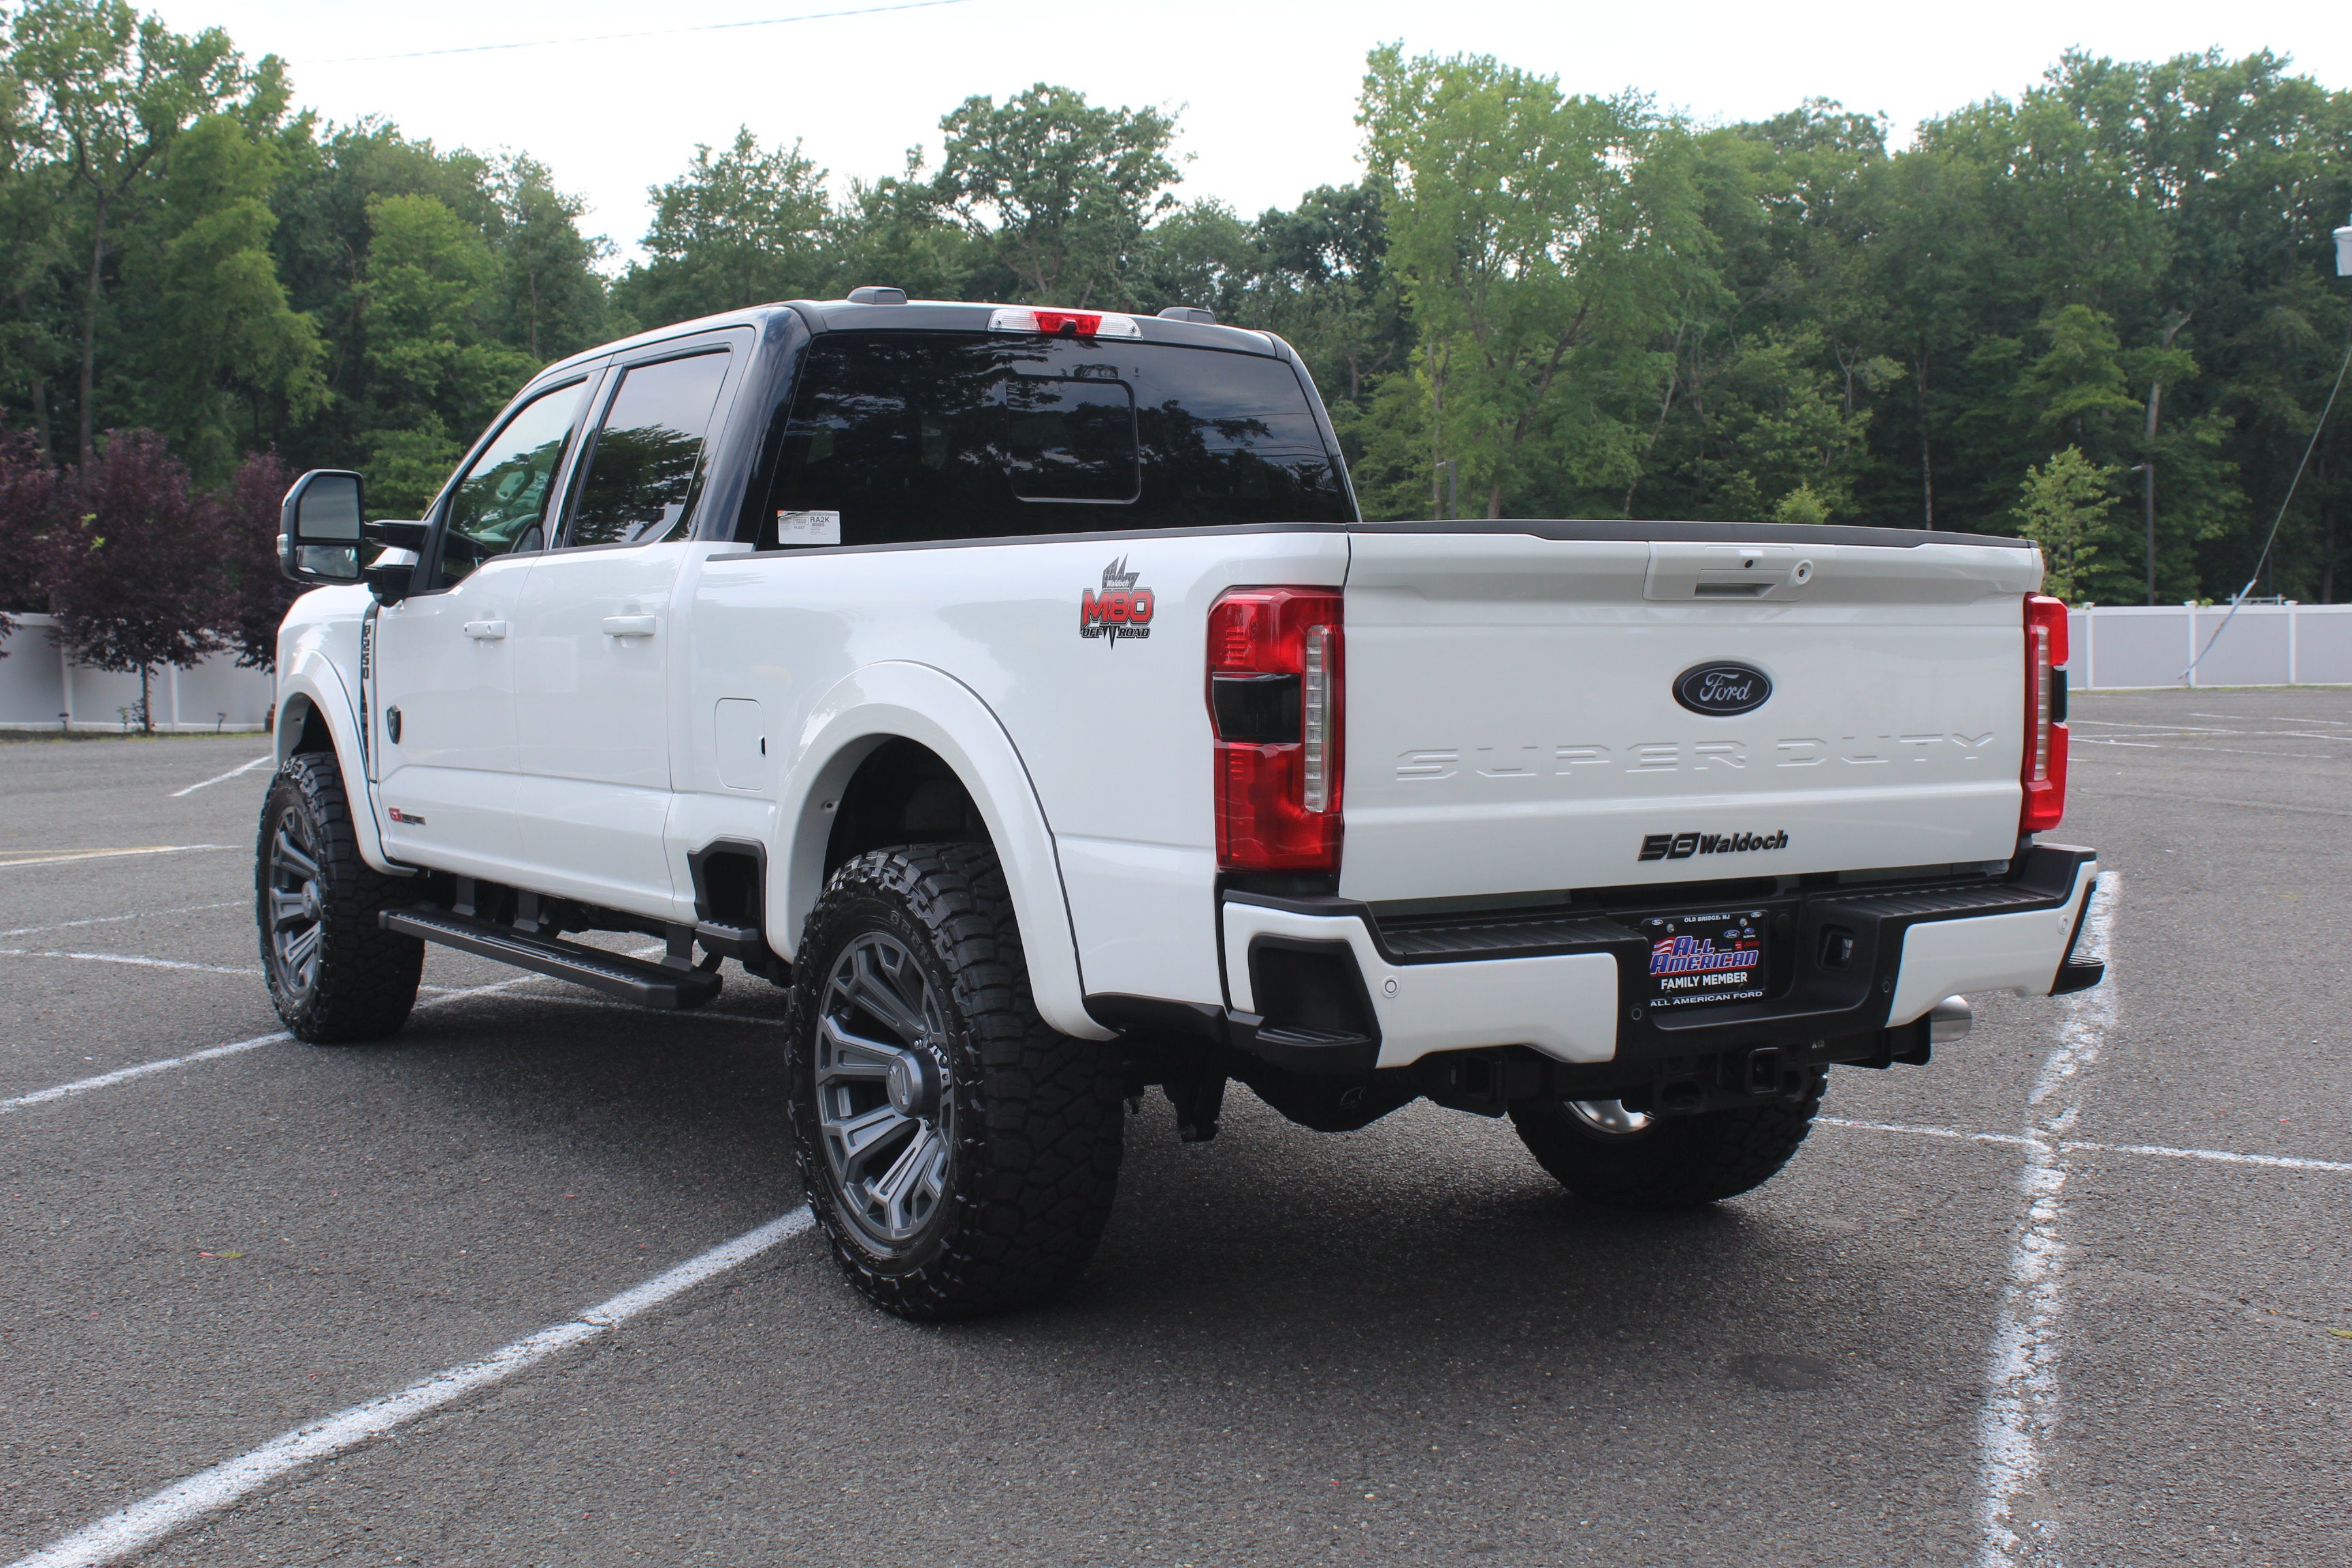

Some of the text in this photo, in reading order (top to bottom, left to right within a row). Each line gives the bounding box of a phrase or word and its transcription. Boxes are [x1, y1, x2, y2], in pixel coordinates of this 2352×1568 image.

[1107, 579, 1129, 587] Waldoch
[1080, 587, 1155, 627] M80
[1081, 627, 1150, 638] OFF ROAD
[1699, 672, 1752, 702] Ford
[1396, 732, 1994, 781] SUPER DUTY
[1699, 830, 1788, 855] Waldoch
[1661, 972, 1748, 990] FAMILY MEMBER
[1673, 994, 1732, 1005] AMERICAN
[1733, 991, 1763, 999] FORD
